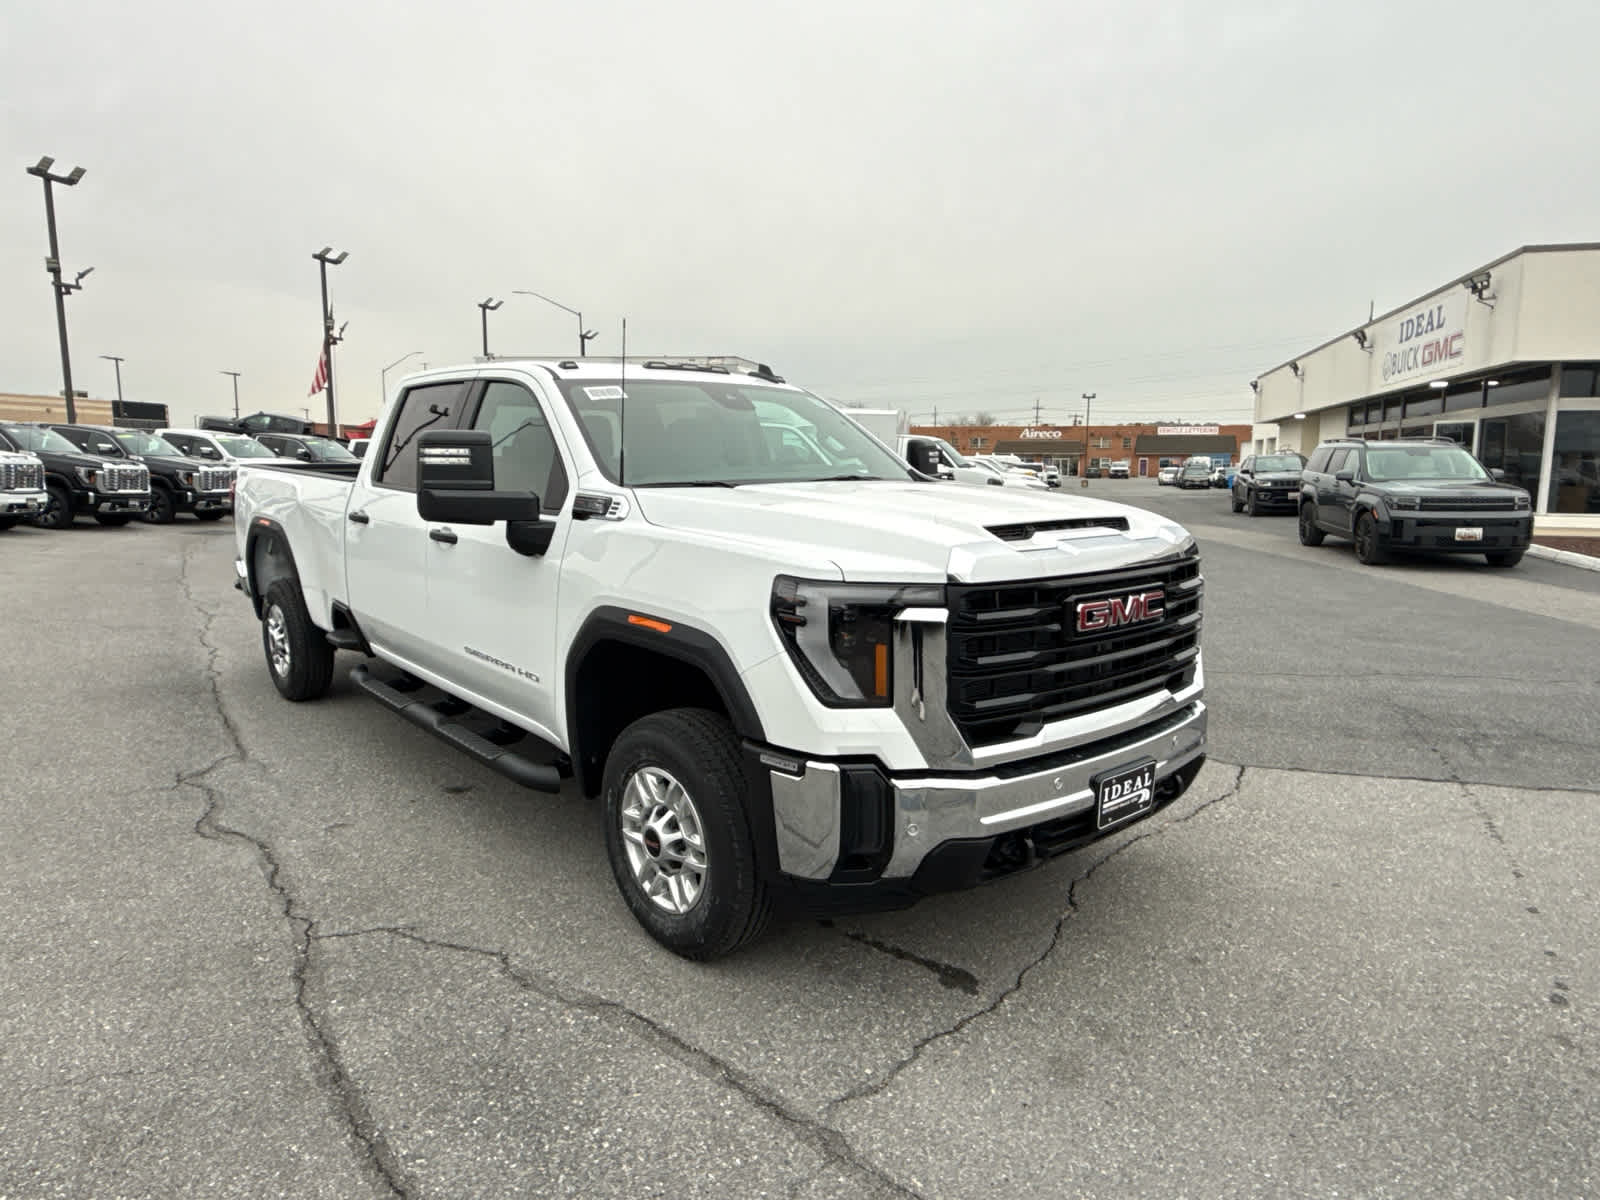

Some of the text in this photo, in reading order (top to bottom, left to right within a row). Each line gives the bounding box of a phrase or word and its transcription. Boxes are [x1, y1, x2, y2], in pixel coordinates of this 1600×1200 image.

[1399, 304, 1446, 344] IDEAL
[1391, 332, 1463, 375] BUICK GMC
[1019, 428, 1062, 439] Aireco
[1076, 590, 1164, 632] GMC
[518, 667, 540, 683] HD
[1103, 772, 1152, 803] IDEAL
